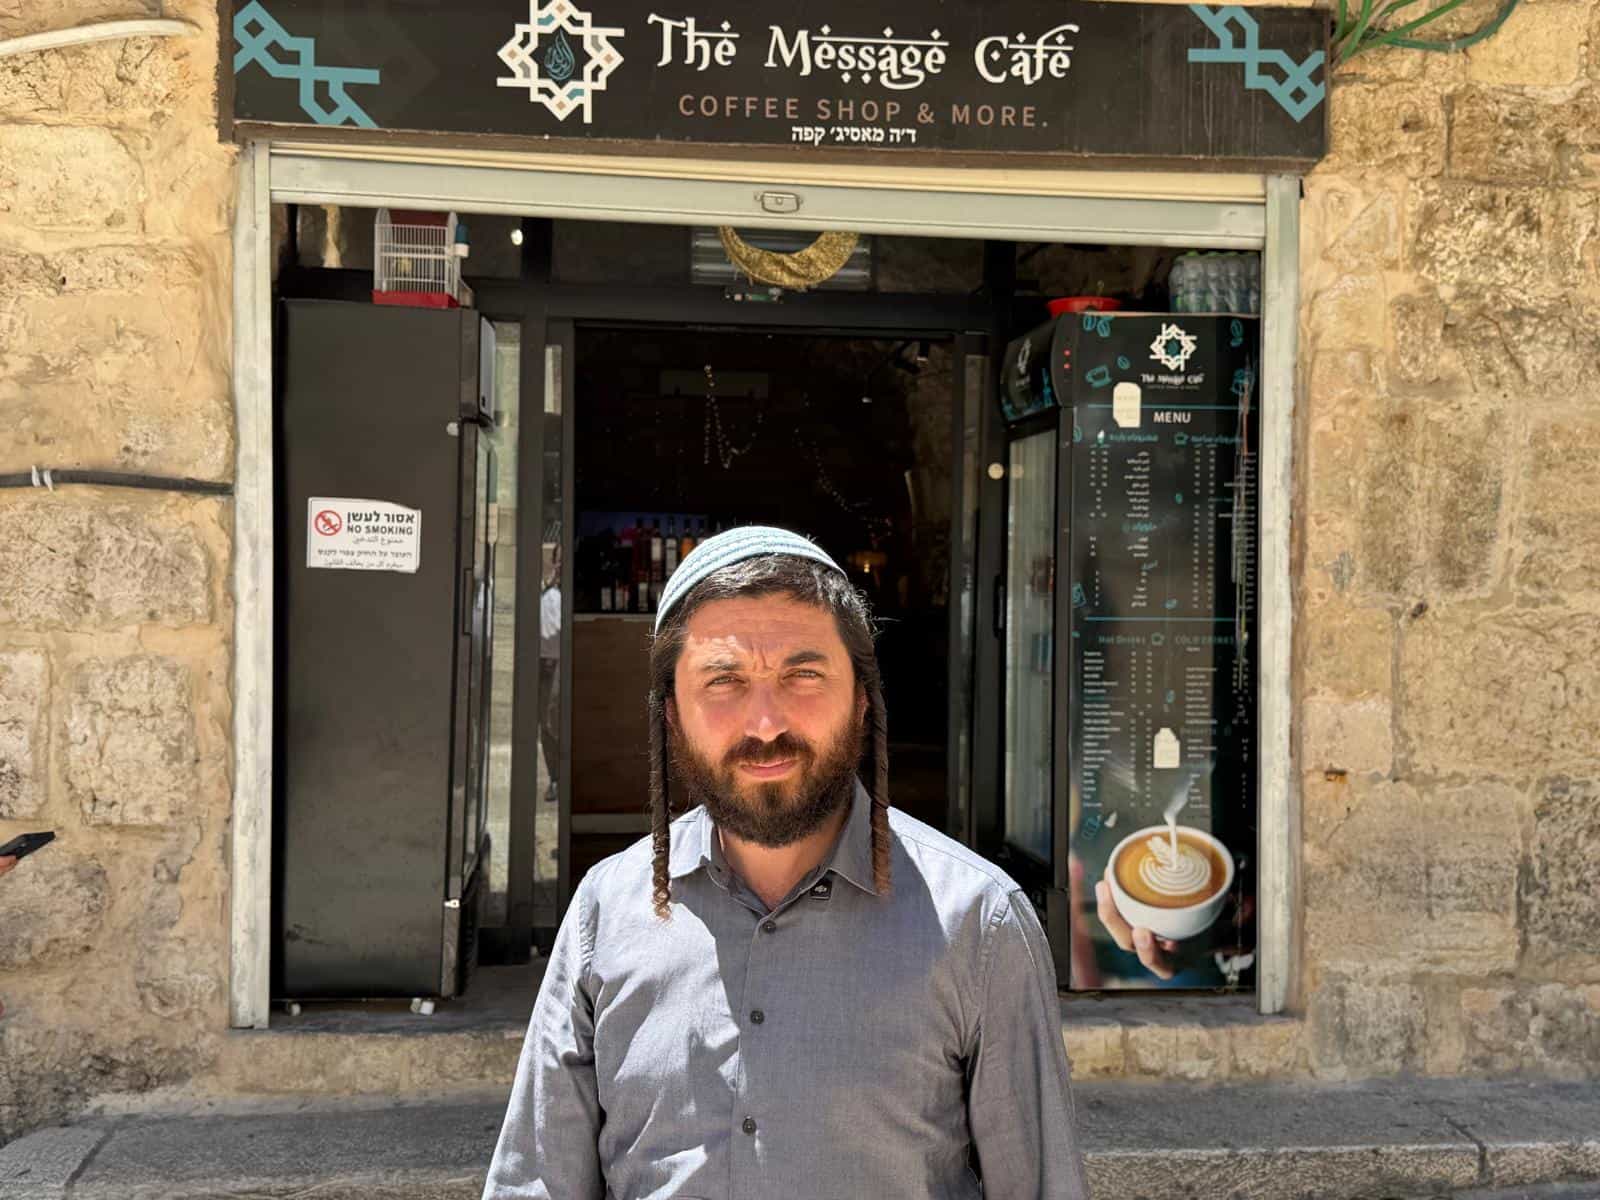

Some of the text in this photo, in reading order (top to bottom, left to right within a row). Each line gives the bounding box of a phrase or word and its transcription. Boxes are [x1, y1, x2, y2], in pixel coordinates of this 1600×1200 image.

[647, 13, 740, 71] The
[764, 24, 949, 90] Message
[678, 94, 1048, 128] COFFEE SHOP & MORE.
[791, 126, 826, 147] קפה
[1153, 411, 1191, 424] MENU
[346, 510, 415, 524] אסור לעשן
[347, 525, 414, 536] NO SMOKING
